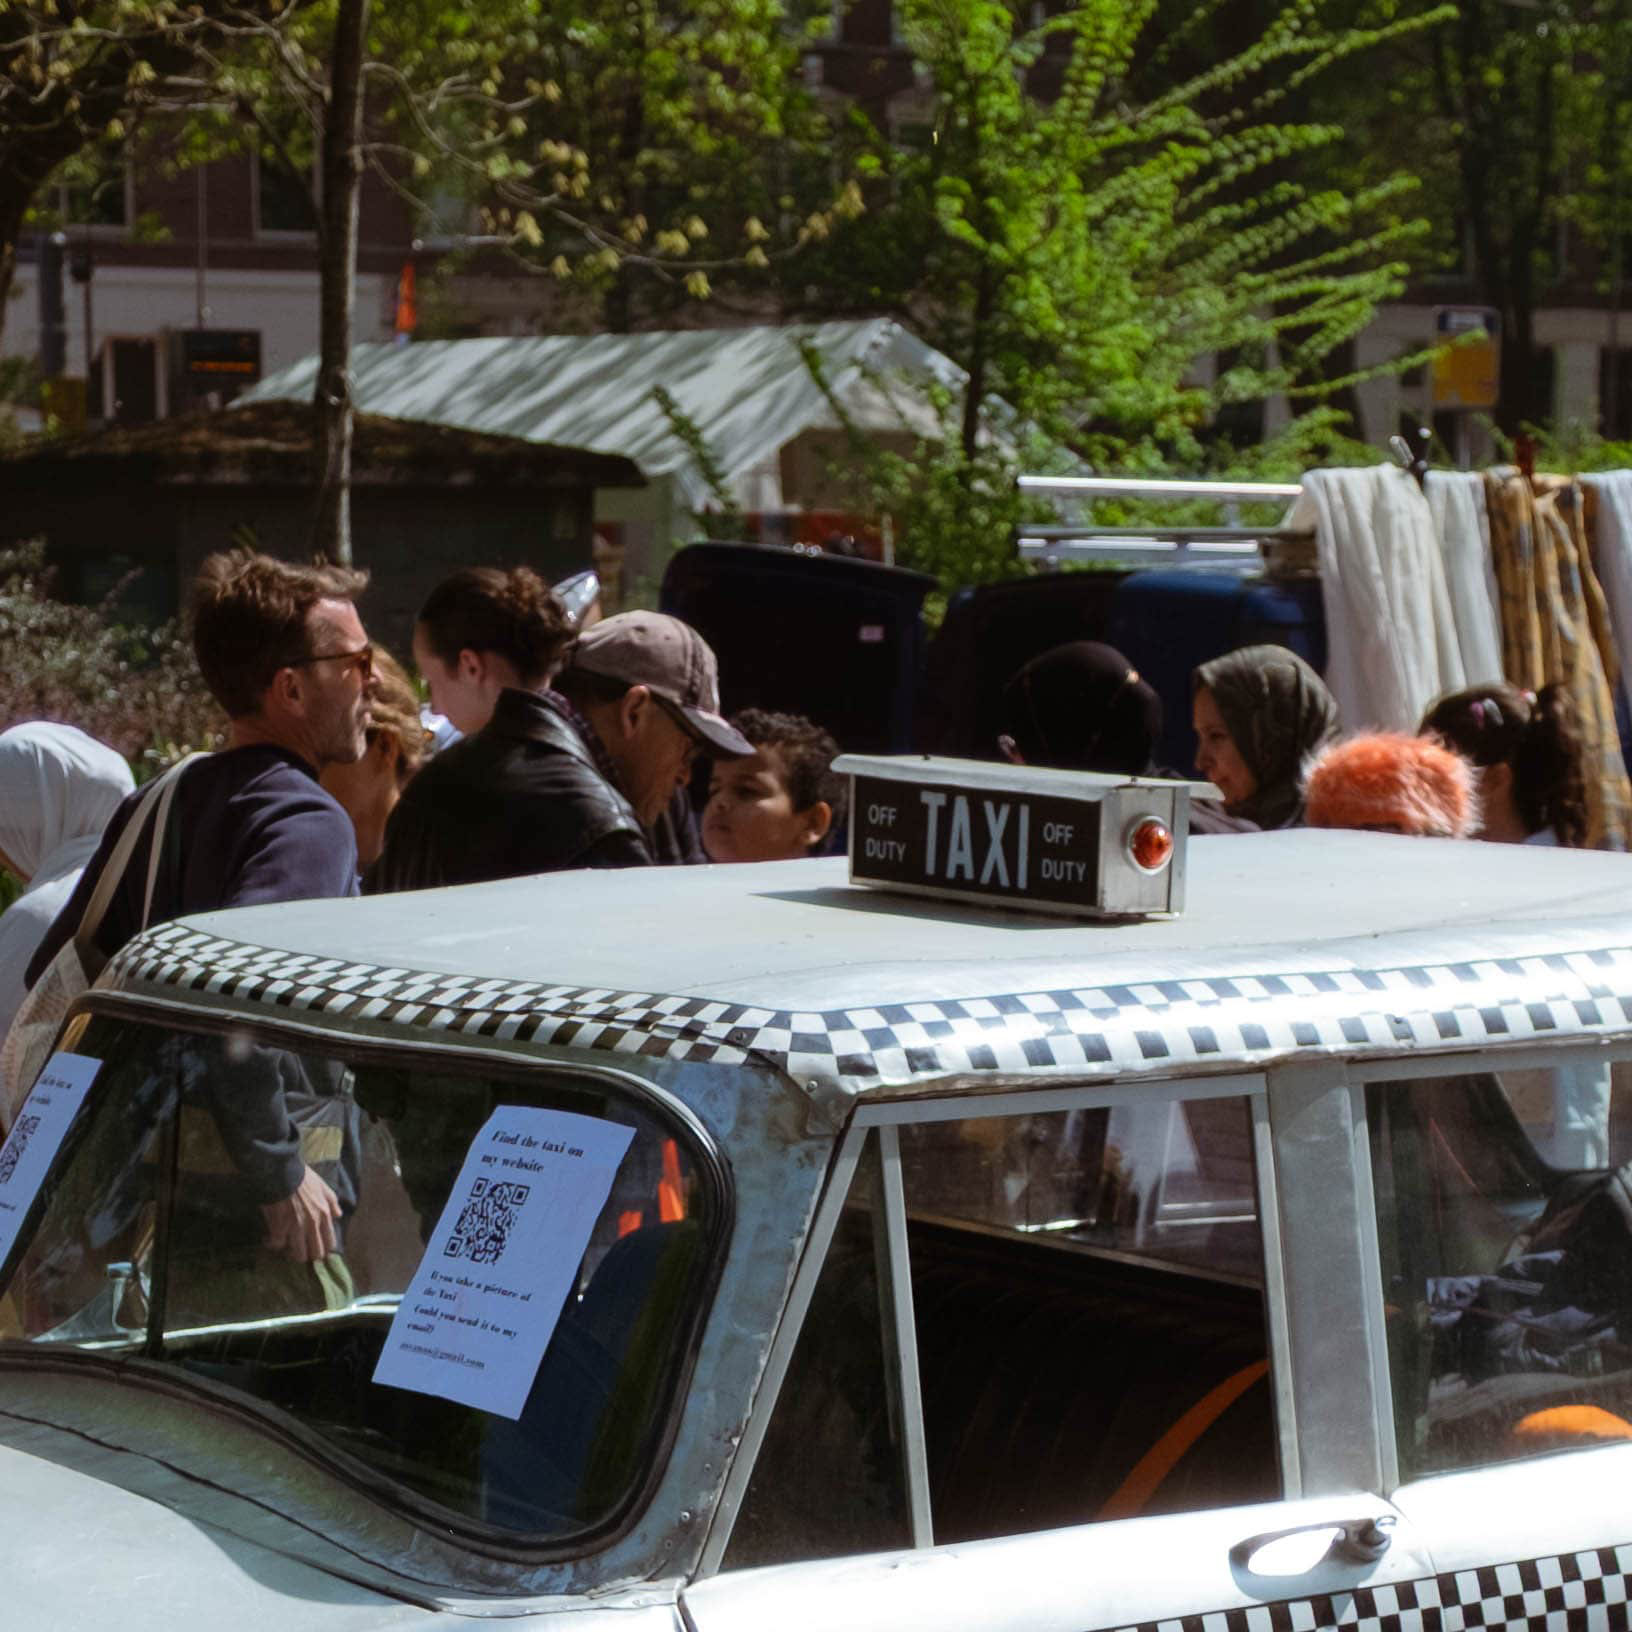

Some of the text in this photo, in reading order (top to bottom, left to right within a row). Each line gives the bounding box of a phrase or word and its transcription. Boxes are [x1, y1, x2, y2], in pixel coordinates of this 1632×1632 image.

[868, 805, 896, 827] OFF
[920, 791, 1029, 890] TAXI
[1043, 823, 1075, 845] OFF
[866, 837, 907, 863] DUTY
[1042, 861, 1088, 883] DUTY
[492, 1130, 584, 1158] Find the taxi on
[481, 1154, 544, 1173] my website
[483, 1283, 517, 1298] picture
[520, 1293, 532, 1302] of
[414, 1304, 439, 1317] Could
[438, 1311, 456, 1321] you
[458, 1316, 479, 1328] send
[490, 1323, 501, 1333] to
[502, 1328, 517, 1340] my
